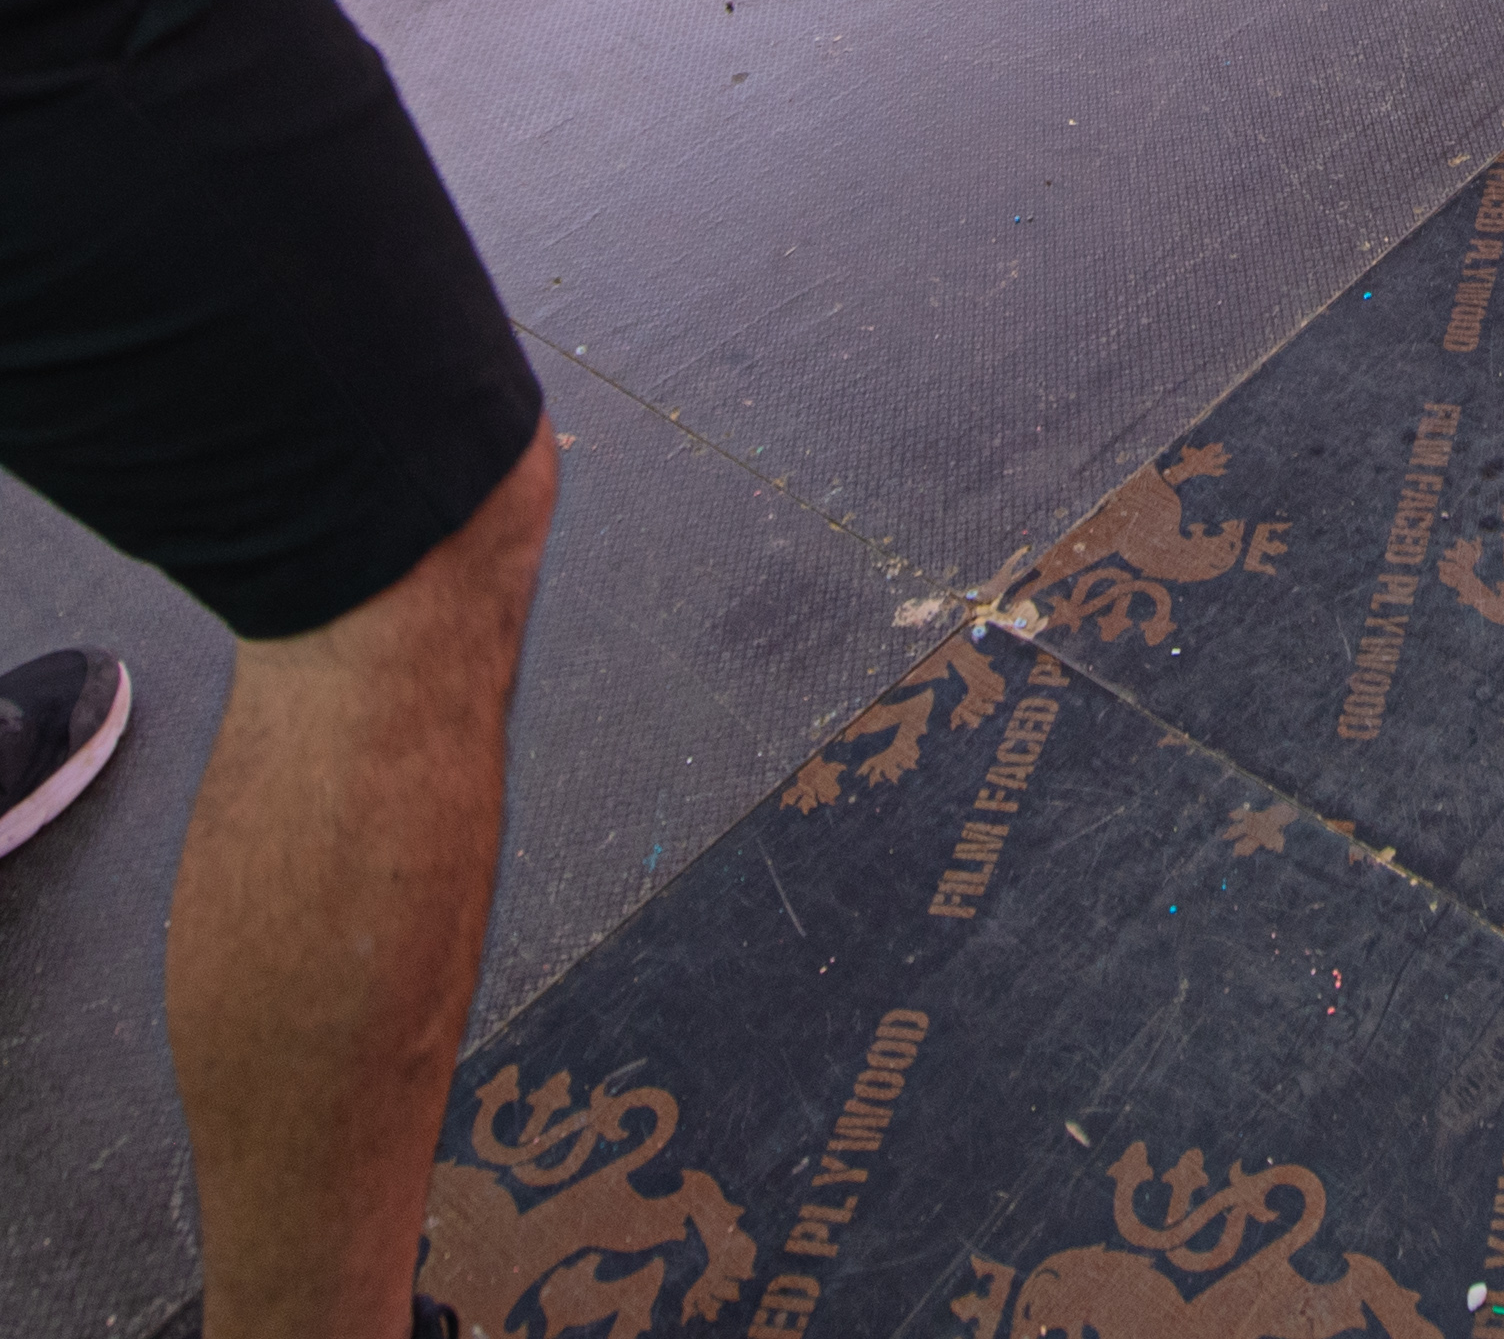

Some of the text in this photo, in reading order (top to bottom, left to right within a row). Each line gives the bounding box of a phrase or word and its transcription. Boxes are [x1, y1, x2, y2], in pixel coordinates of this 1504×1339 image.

[1384, 473, 1444, 565] FACED
[1336, 571, 1420, 742] PLYWOOD
[927, 821, 1007, 921] FILM
[974, 693, 1061, 813] FACED
[785, 1007, 931, 1257] PLYWOOD
